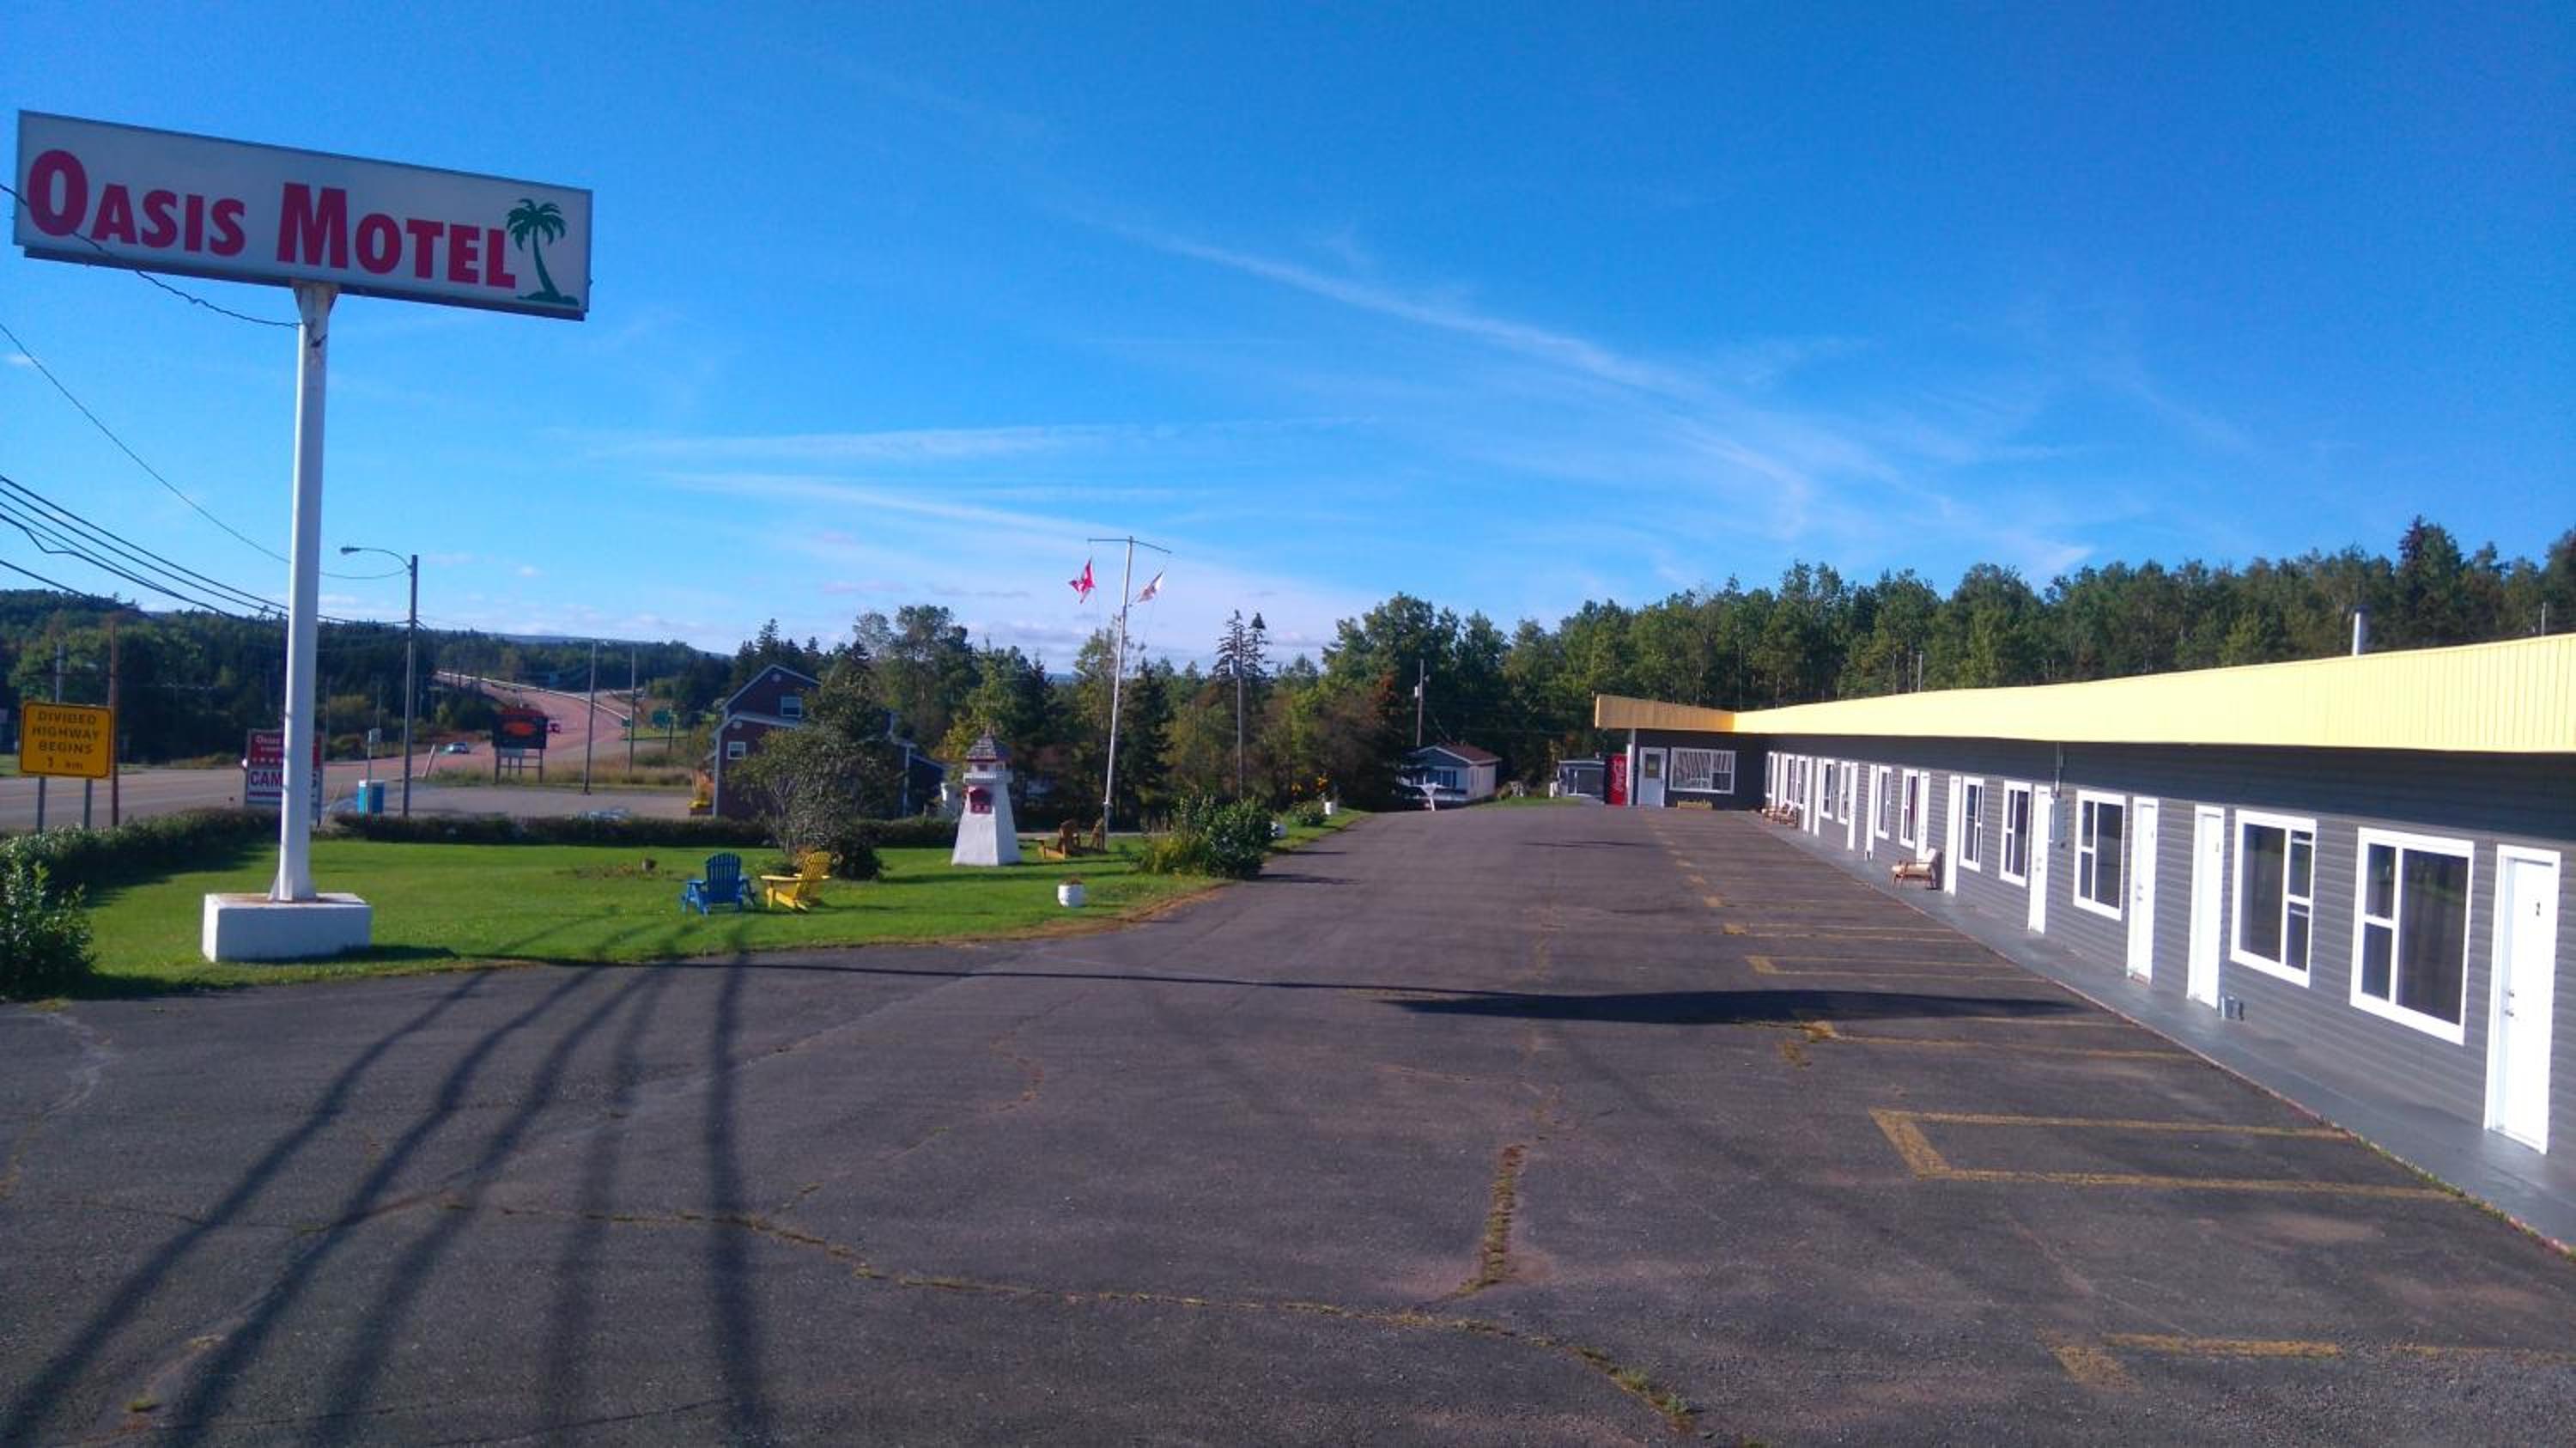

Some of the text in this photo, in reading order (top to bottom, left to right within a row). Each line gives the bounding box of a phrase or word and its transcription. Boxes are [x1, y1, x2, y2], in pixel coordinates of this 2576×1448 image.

[27, 149, 517, 289] OASIS MOTEL
[38, 711, 96, 725] DIVIDED
[32, 727, 99, 740] HIGHWAY
[39, 741, 94, 755] BEGINS
